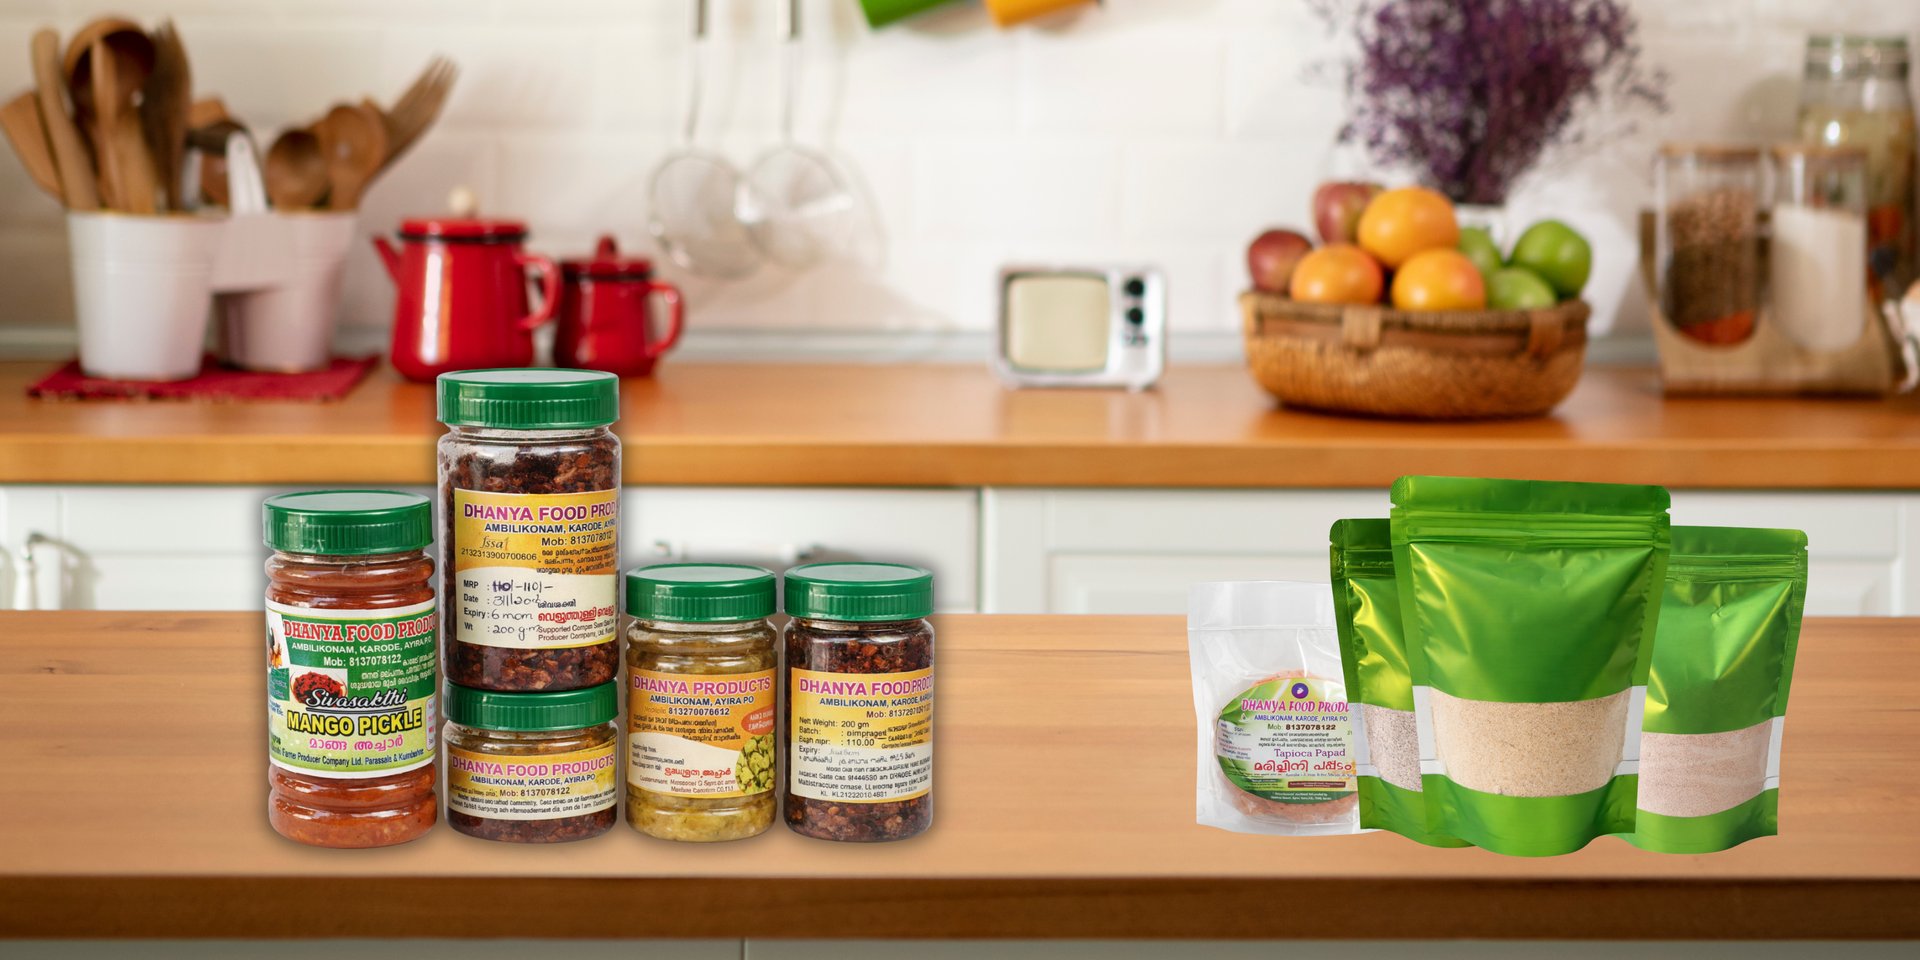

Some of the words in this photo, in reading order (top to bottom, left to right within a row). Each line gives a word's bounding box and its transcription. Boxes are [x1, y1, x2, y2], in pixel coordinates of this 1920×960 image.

[464, 503, 533, 521] DHANYA
[538, 505, 587, 522] FOOD
[484, 523, 566, 534] AMBILIKONAM,
[541, 537, 567, 547] Mob:
[463, 580, 479, 589] MRP
[463, 593, 479, 603] Date
[491, 609, 500, 620] 6
[283, 621, 343, 641] DHANYA
[346, 624, 395, 642] FOOD
[464, 621, 473, 631] Wt
[492, 625, 515, 633] 200
[292, 642, 358, 654] AMBILIKONAM,
[359, 644, 403, 653] KARODE,
[323, 657, 346, 667] Mob:
[349, 654, 401, 667] 8137078122
[634, 676, 689, 695] DHANYA
[693, 677, 771, 696] PRODUCTS
[799, 678, 867, 696] DHANYA
[871, 681, 910, 696] FOOD
[306, 688, 407, 708] Sivasakthi
[650, 695, 713, 707] AMBILIKONAM,
[714, 697, 742, 705] AYIRA
[743, 695, 754, 703] PO
[819, 697, 889, 708] AMBILIKONAM,
[1242, 699, 1286, 713] DHANYA
[1289, 700, 1315, 712] FOOD
[287, 710, 354, 736] MANGO
[358, 708, 422, 735] PICKLE
[1274, 749, 1312, 759] Tapioca
[1315, 748, 1346, 759] Papad
[322, 756, 350, 767] Company
[452, 756, 503, 776] DHANYA
[507, 764, 548, 777] FOOD
[552, 753, 615, 775] PRODUCTS
[470, 775, 526, 787] AMBILIKONAM,
[528, 777, 563, 786] KARODE,
[564, 775, 585, 784] AYIRA
[586, 773, 596, 782] PO
[499, 789, 519, 797] Mob:
[520, 787, 570, 797] 8137078122
